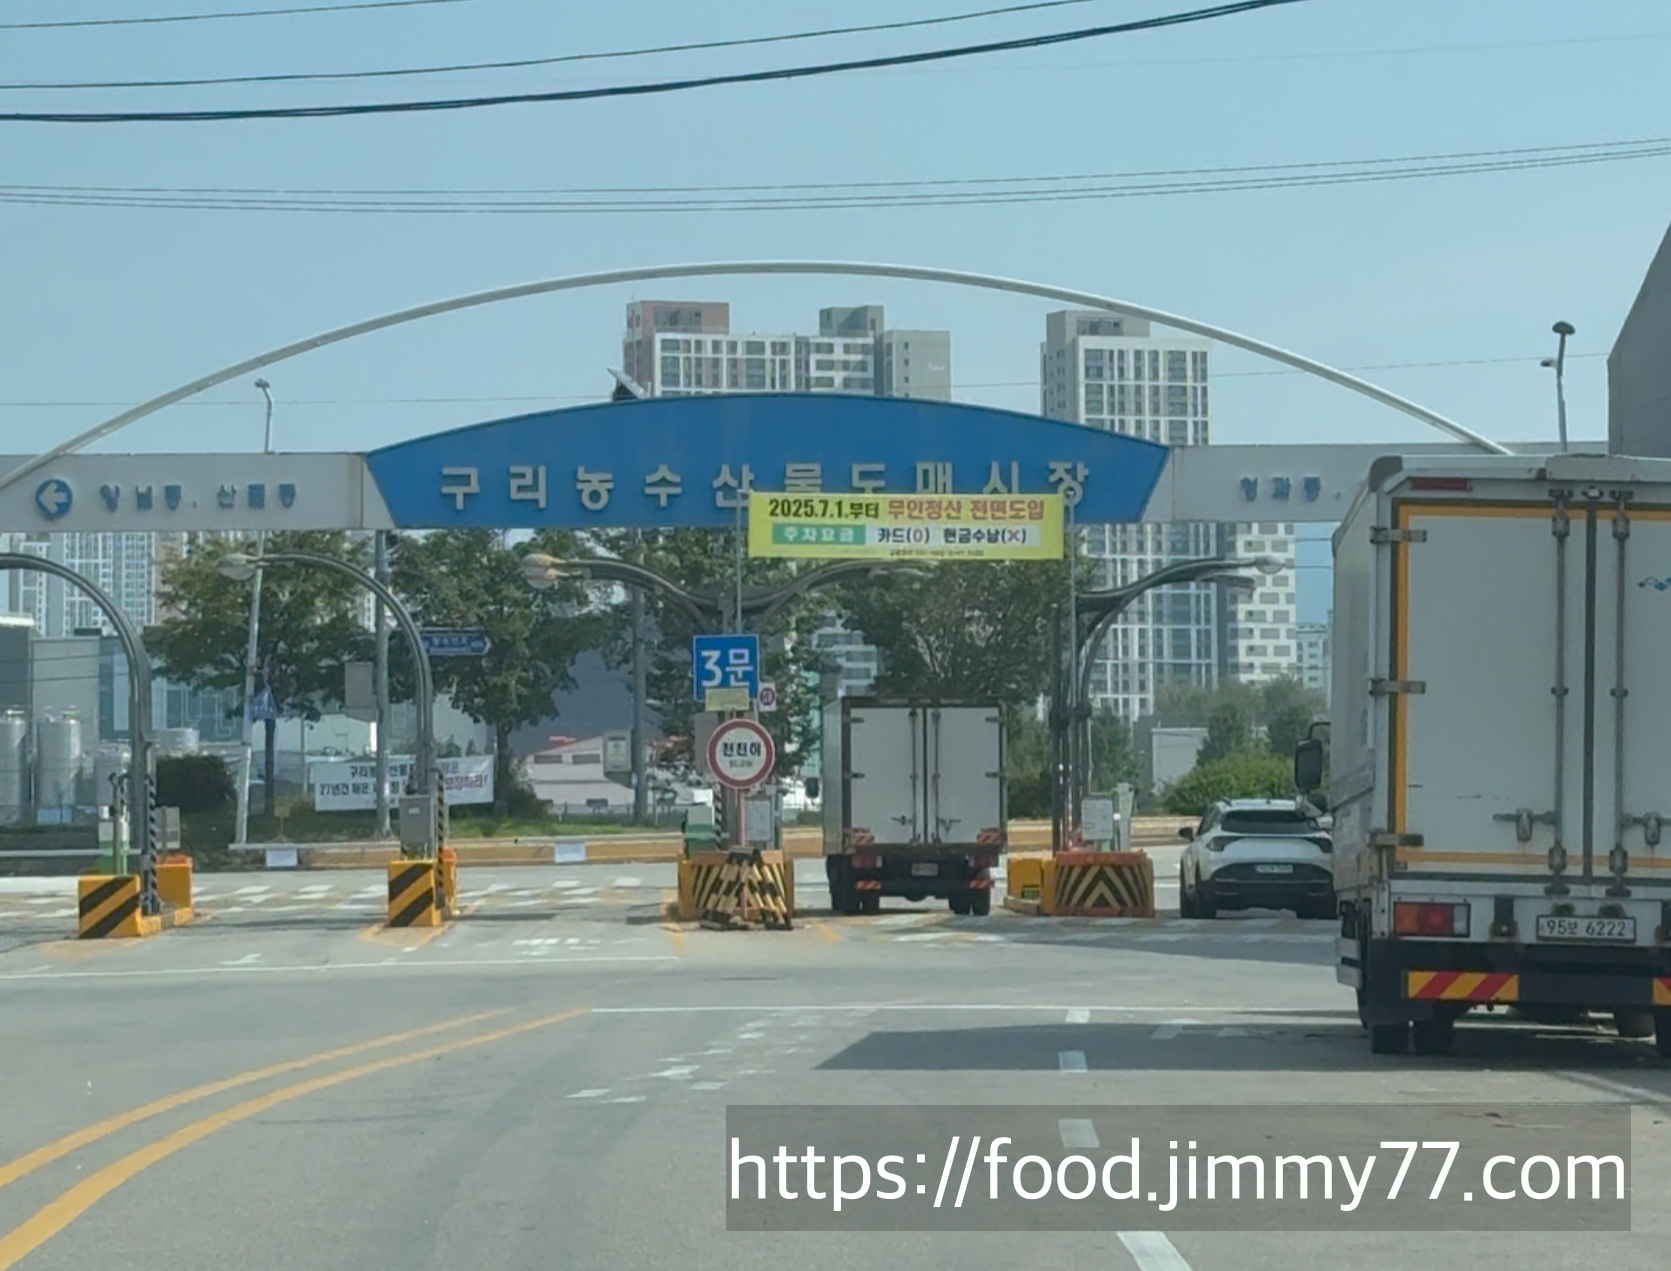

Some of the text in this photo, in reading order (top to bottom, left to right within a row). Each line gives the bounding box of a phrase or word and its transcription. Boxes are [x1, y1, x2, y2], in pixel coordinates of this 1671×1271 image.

[441, 460, 1090, 511] 구리농수산물도매시장
[768, 498, 1045, 521] 2025.7.1.부터 무인정산 전면도입
[783, 527, 855, 542] 주차요금
[701, 648, 754, 687] 3문
[1585, 920, 1627, 937] 6222
